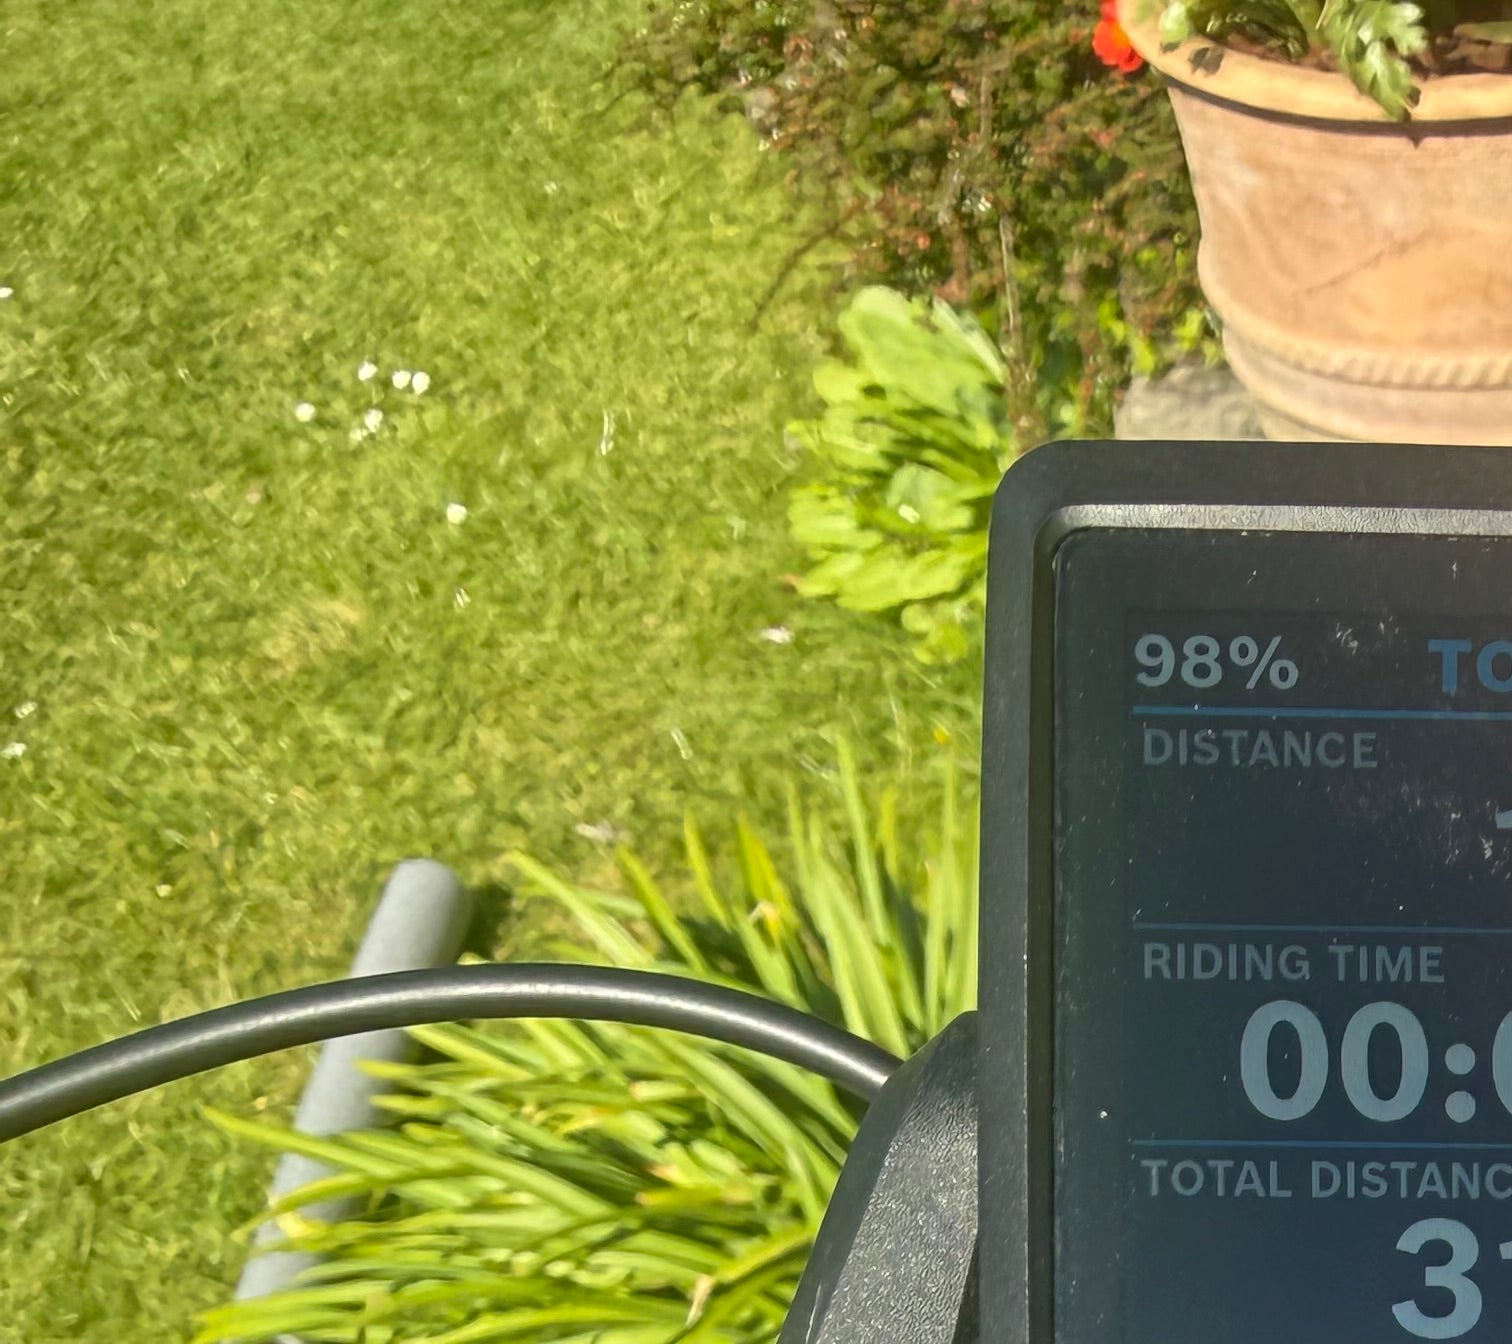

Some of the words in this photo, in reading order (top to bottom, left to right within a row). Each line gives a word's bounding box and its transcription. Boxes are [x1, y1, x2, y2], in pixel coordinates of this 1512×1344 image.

[1134, 634, 1299, 690] 98%
[1142, 728, 1379, 768] DISTANCE
[1143, 942, 1310, 982] RIDING
[1328, 944, 1446, 984] TIME
[1141, 1159, 1292, 1198] TOTAL
